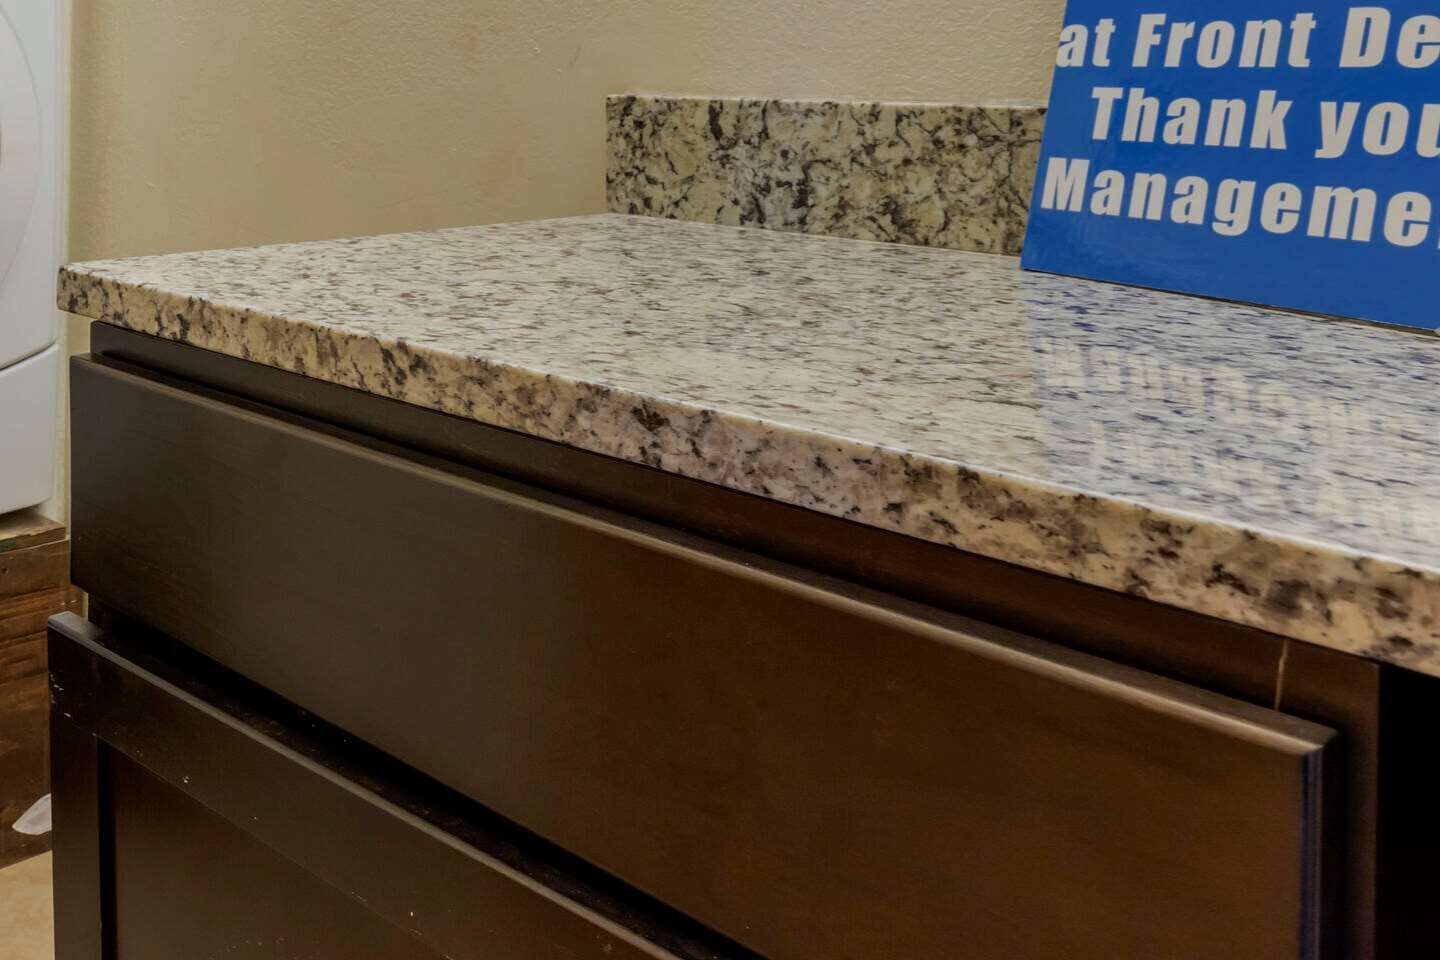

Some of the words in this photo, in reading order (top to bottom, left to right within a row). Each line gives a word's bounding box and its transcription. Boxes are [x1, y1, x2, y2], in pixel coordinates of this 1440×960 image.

[1056, 19, 1115, 67] at
[1133, 13, 1316, 67] Front
[1340, 7, 1440, 68] De
[1092, 87, 1292, 149] Thank
[1041, 157, 1440, 248] Manageme
